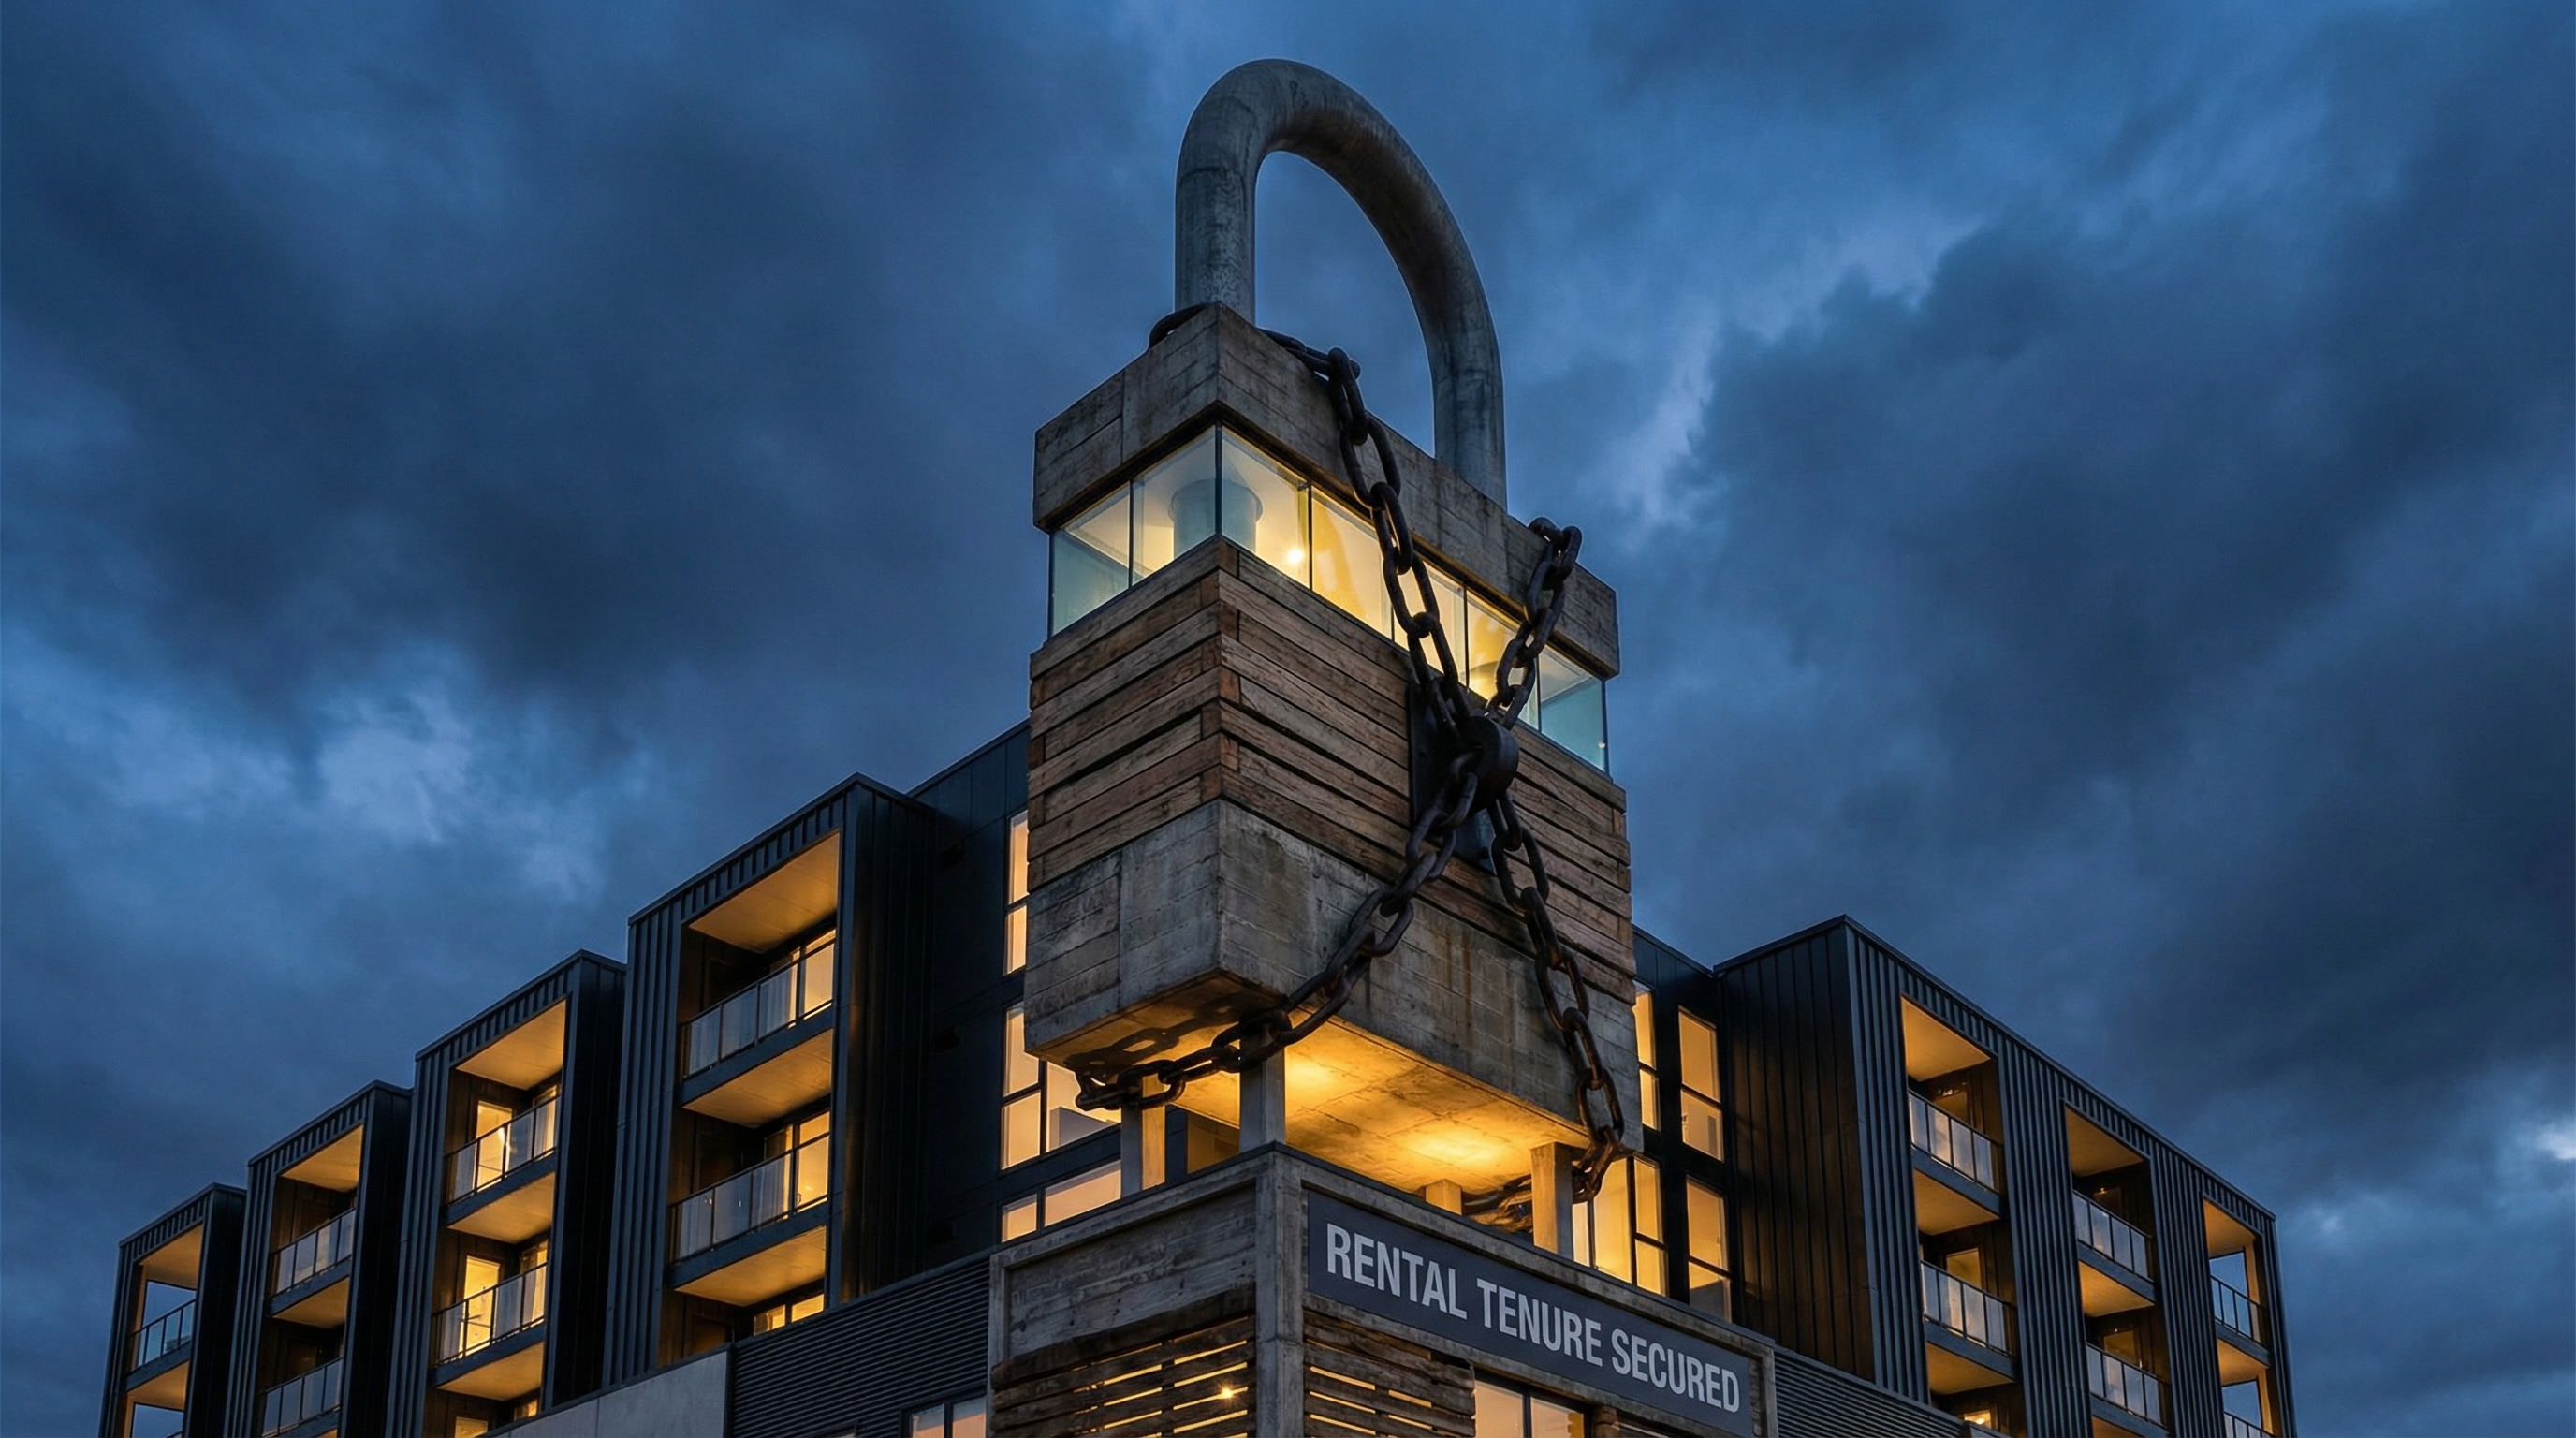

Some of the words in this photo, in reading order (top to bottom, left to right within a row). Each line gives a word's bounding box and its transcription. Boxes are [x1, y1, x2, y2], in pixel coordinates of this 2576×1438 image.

[1327, 1223, 1467, 1320] RENTAL
[1477, 1278, 1603, 1367] TENURE
[1611, 1329, 1740, 1413] SECURED
